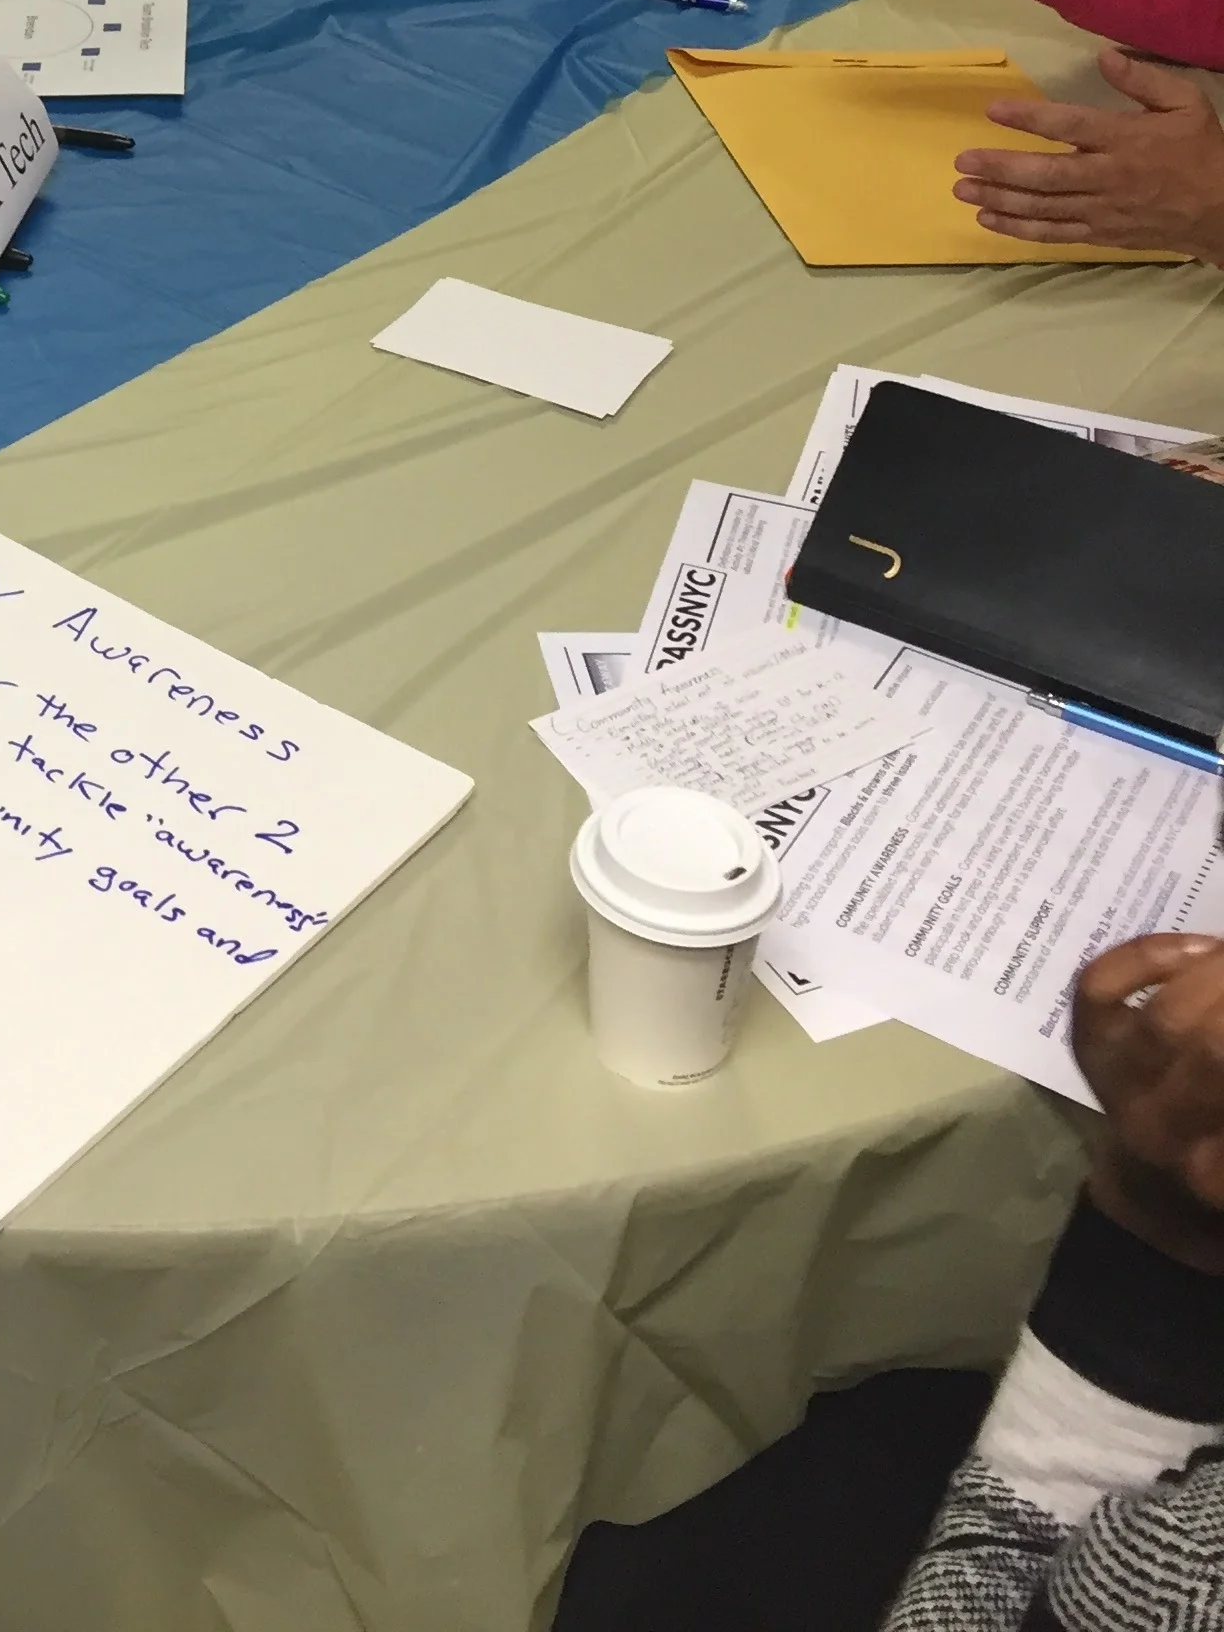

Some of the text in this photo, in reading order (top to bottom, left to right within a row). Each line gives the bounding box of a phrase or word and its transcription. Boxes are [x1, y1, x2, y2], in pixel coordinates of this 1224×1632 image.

[52, 607, 301, 763] Awareness
[7, 735, 129, 823] tackle
[36, 692, 98, 744] the
[112, 742, 247, 823] other
[255, 819, 296, 858] 2
[88, 864, 187, 924] goals
[195, 922, 280, 969] and
[834, 874, 876, 929] COMMUNITY
[868, 824, 910, 878] AWARENESS
[903, 902, 944, 958] COMMUNITY
[936, 872, 963, 905] GOALS
[992, 937, 1033, 996] COMMUNITY
[1023, 898, 1055, 941] SUPPORT
